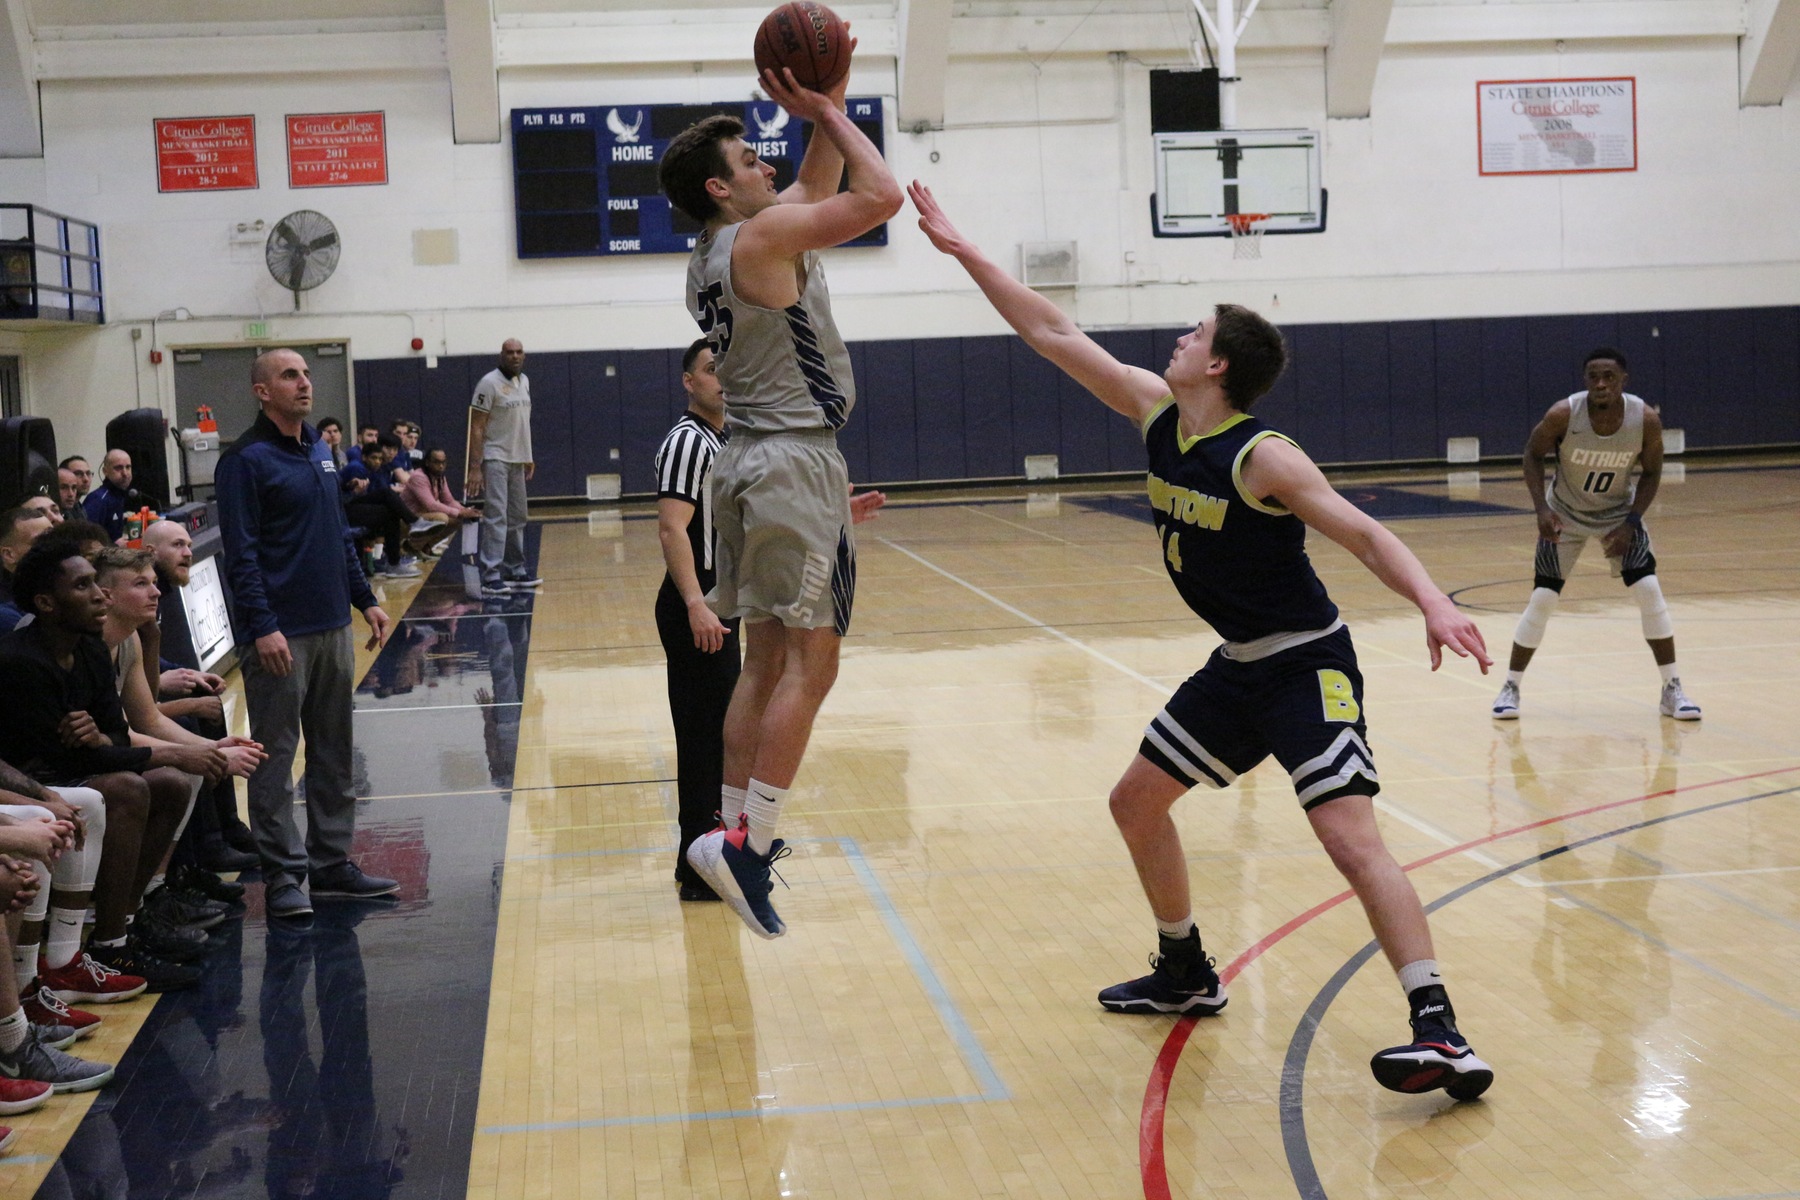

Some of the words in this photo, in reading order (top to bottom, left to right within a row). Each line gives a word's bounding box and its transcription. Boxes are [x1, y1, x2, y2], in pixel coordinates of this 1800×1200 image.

[1488, 86, 1532, 100] STATE
[1536, 84, 1625, 99] CHAMPIONS
[856, 104, 872, 115] PTS
[523, 114, 543, 126] PLYR
[549, 113, 563, 125] FLS
[570, 112, 586, 124] PTS
[161, 141, 190, 149] MEN'S
[191, 139, 249, 149] BASKETBALL
[293, 137, 321, 145] MEN'S
[322, 135, 379, 144] BASKETBALL
[325, 148, 348, 159] 2011
[611, 145, 654, 162] HOME
[752, 141, 788, 157] UEST
[194, 152, 219, 163] 2012
[176, 167, 206, 176] FINAL
[210, 165, 239, 175] FOUR
[297, 163, 327, 172] STATE
[332, 161, 378, 170] FINALIST
[607, 198, 639, 212] FOULS
[609, 239, 641, 252] SCORE
[697, 279, 734, 357] 25
[1570, 447, 1634, 468] CITRUS
[1583, 470, 1617, 495] 10
[788, 549, 830, 624] OWLS
[1316, 668, 1361, 724] B
